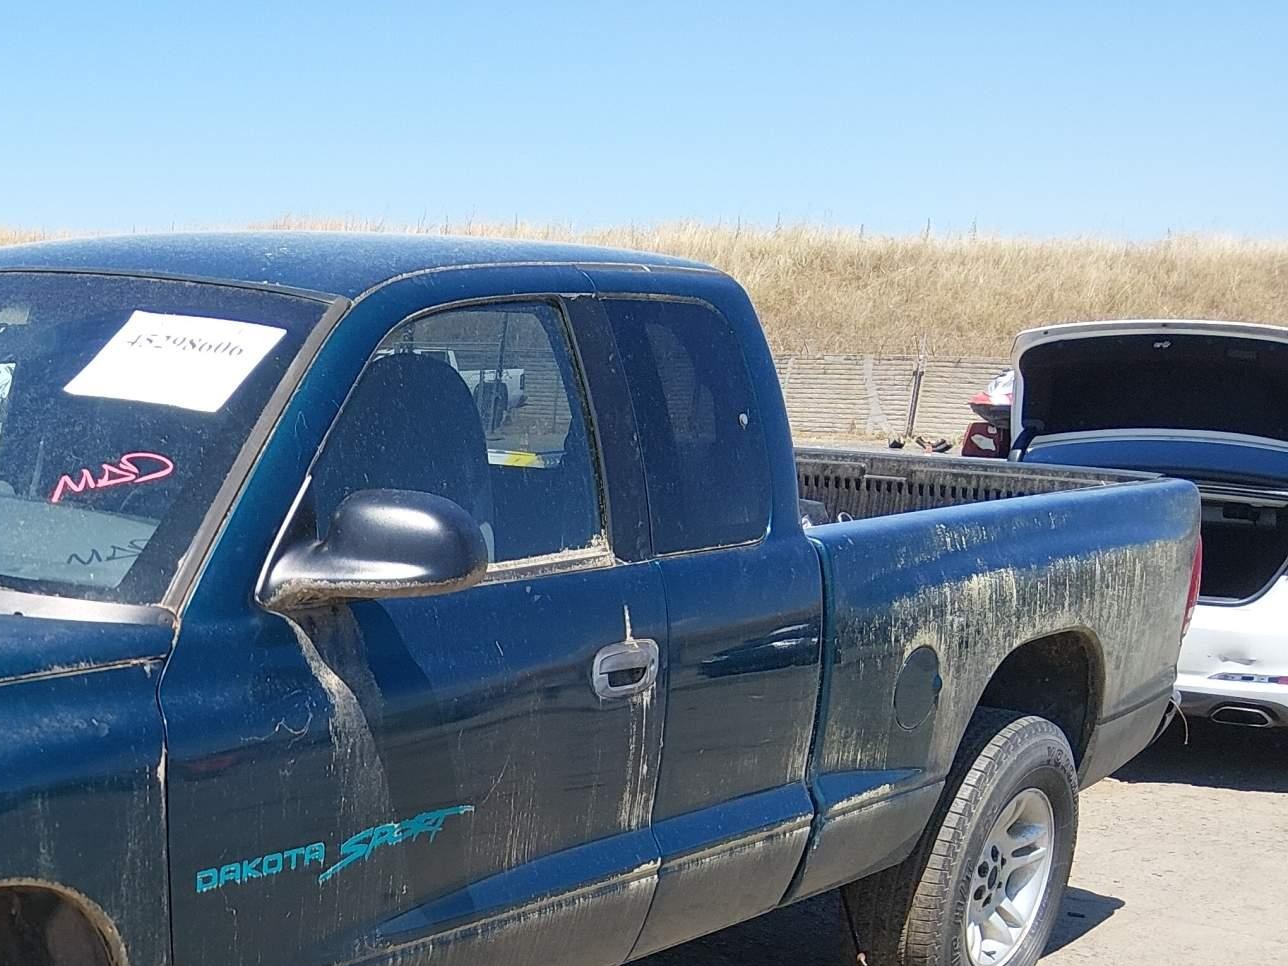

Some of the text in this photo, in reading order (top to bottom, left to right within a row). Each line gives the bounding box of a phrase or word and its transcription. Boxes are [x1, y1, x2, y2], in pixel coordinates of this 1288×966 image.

[51, 451, 174, 504] MAD
[196, 804, 475, 893] DAKOTA SPORT
